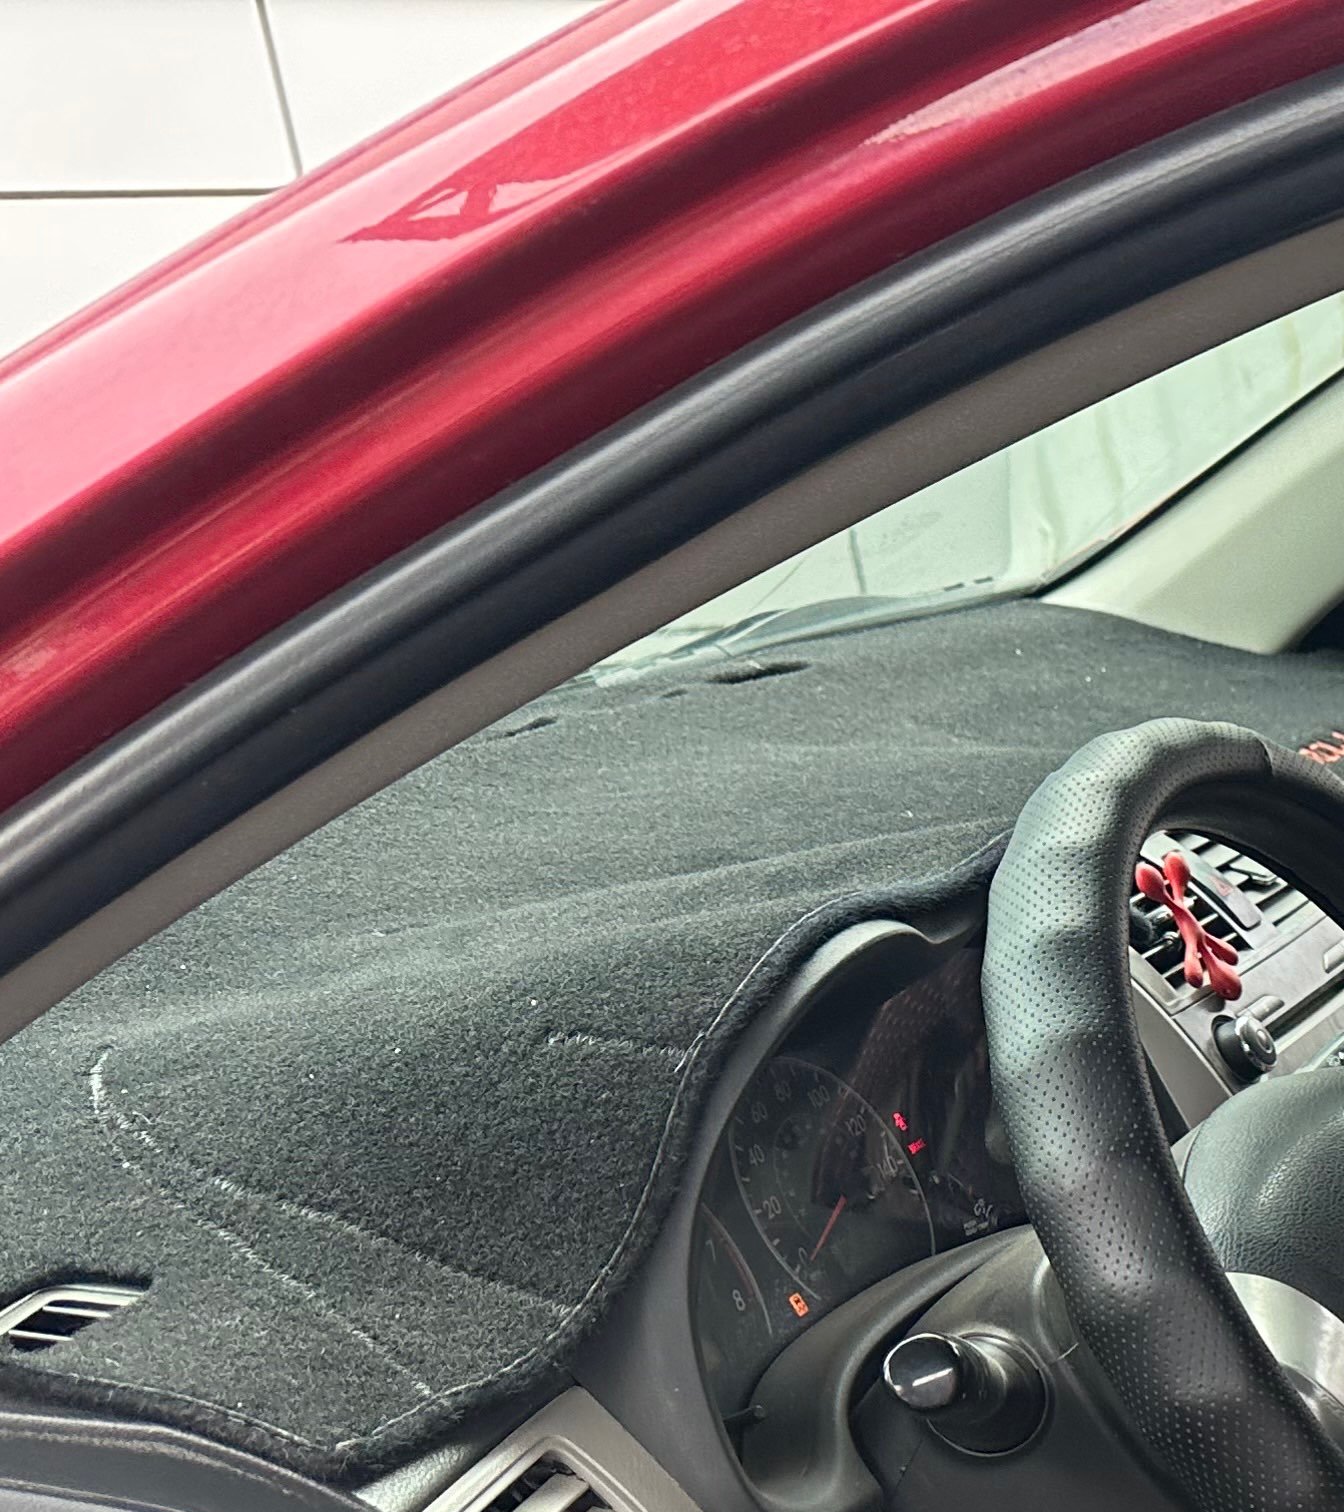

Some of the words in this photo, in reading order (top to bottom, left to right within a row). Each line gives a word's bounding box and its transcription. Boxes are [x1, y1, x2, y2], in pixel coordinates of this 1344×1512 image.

[844, 1115, 867, 1136] 120
[750, 1143, 765, 1167] 40
[763, 1195, 782, 1219] 20
[732, 1289, 746, 1311] 8
